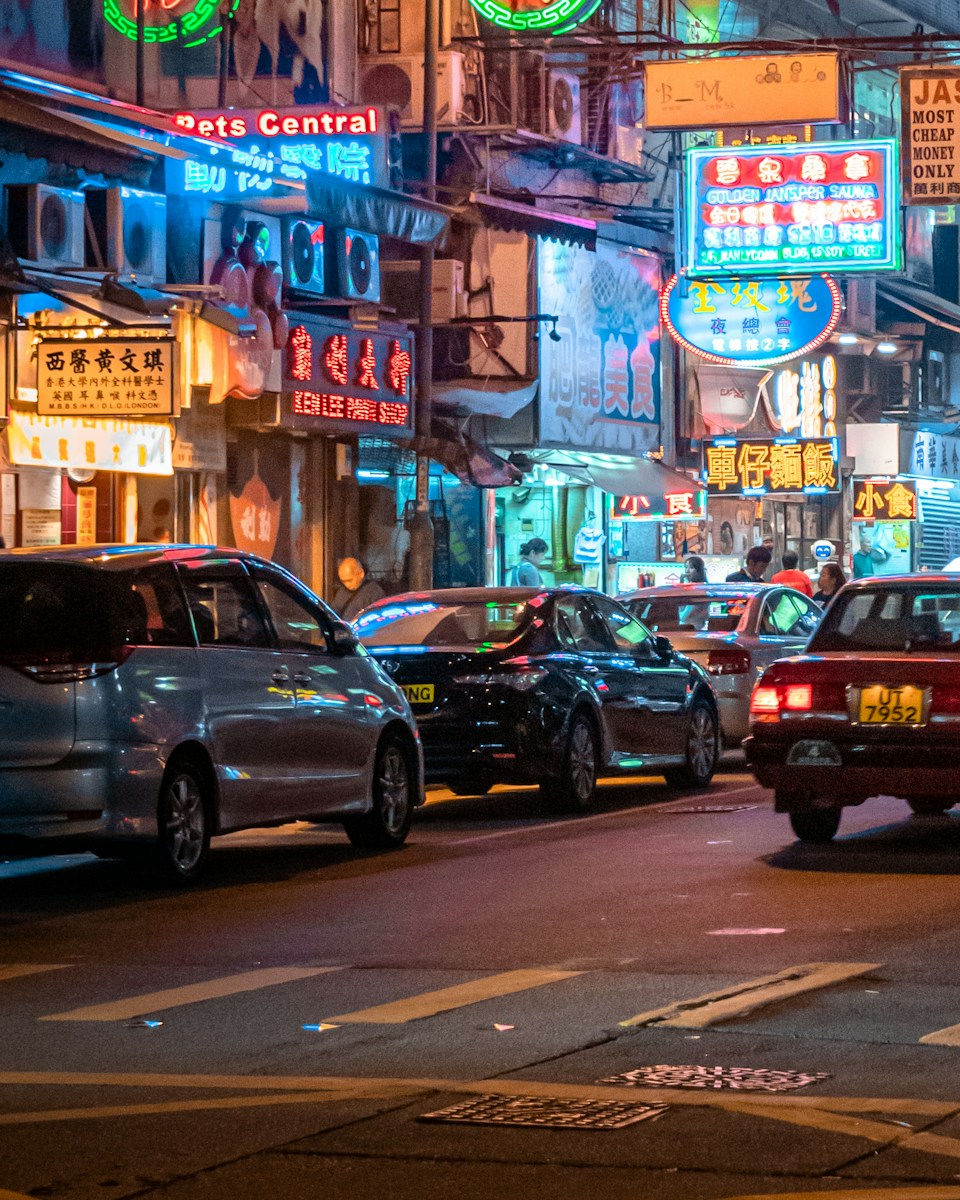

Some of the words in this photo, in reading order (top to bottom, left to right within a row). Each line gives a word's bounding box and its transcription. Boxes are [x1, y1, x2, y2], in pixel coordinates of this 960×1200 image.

[258, 108, 378, 136] Central
[912, 110, 955, 124] MOST
[912, 128, 955, 142] CHEAP
[912, 146, 955, 160] MONEY
[913, 165, 955, 179] ONLY
[710, 317, 791, 334] 夜總會
[855, 483, 915, 518] 小食
[878, 688, 904, 706] UT
[865, 705, 918, 723] 7952
